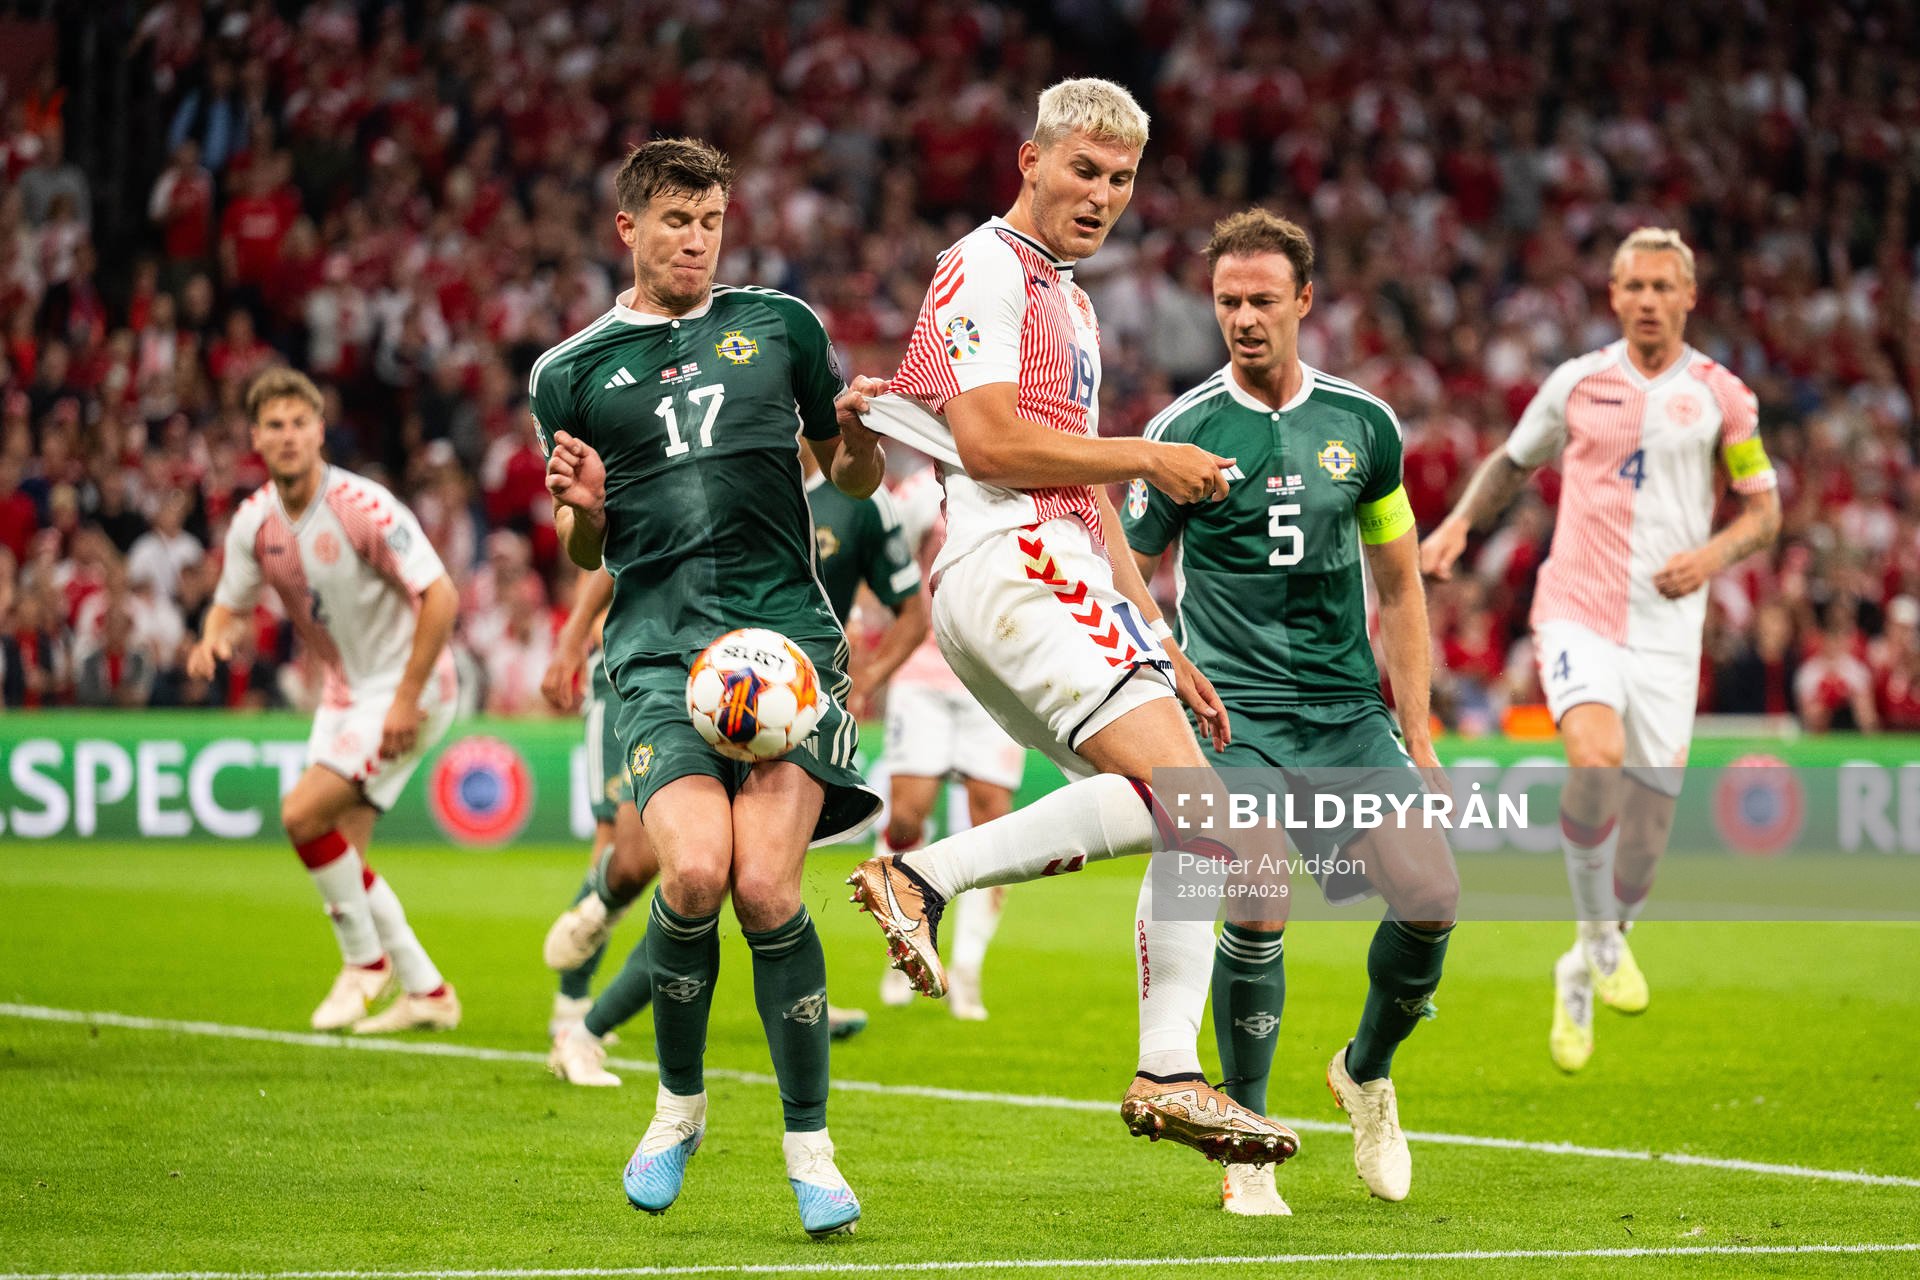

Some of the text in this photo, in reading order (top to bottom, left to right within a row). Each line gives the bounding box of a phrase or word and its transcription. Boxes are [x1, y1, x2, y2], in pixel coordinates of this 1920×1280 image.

[1068, 342, 1095, 408] 19
[653, 383, 725, 458] 17
[1618, 448, 1647, 489] 4
[1268, 503, 1305, 567] 5
[721, 645, 785, 671] SELECT
[1137, 919, 1150, 1001] DANMARK
